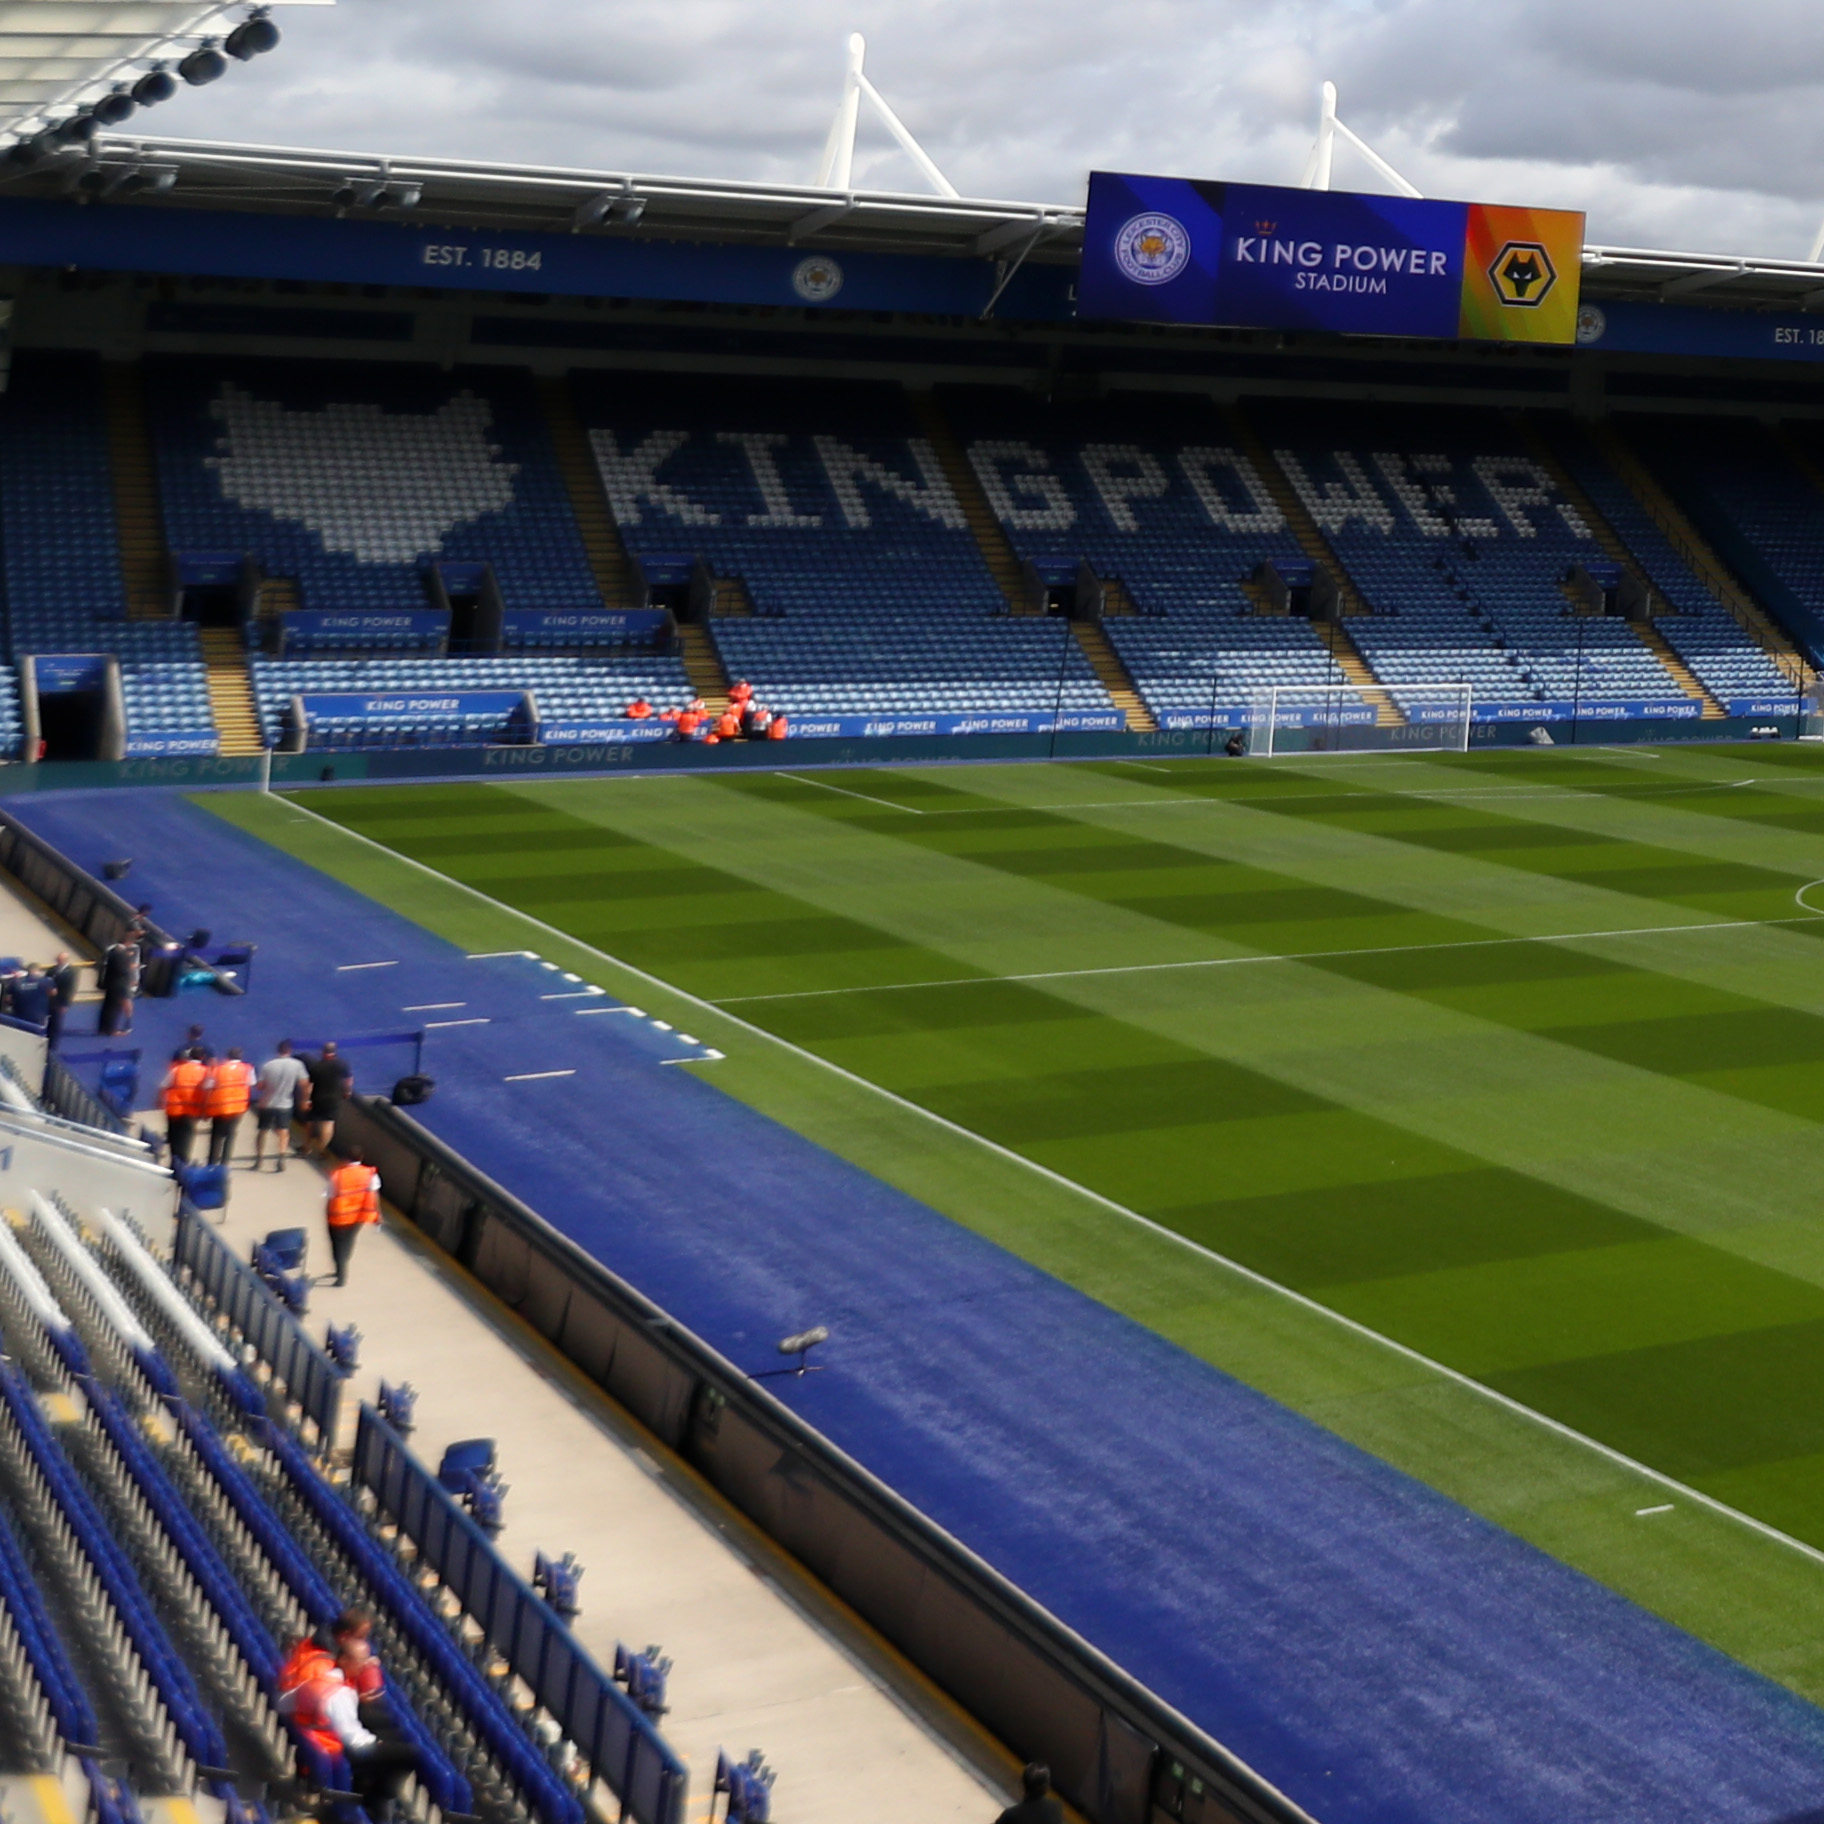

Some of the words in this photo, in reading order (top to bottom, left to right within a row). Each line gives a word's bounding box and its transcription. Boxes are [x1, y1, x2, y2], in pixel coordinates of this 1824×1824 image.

[423, 245, 473, 266] EST.
[482, 247, 542, 271] 1884
[1236, 237, 1323, 267] KING
[1334, 244, 1448, 276] POWER
[1296, 271, 1387, 295] STADIUM
[1774, 327, 1804, 344] EST.
[322, 616, 359, 628] KING
[362, 616, 413, 628] POWER
[545, 616, 576, 626] KING
[581, 615, 626, 626] POWER
[367, 700, 403, 712] KING
[408, 698, 460, 711] POWER
[1644, 706, 1665, 715] KING
[1751, 703, 1772, 713] KING
[1498, 708, 1520, 717] KING
[1523, 708, 1553, 717] POWER
[898, 720, 936, 730] POWER
[991, 719, 1029, 729] POWER
[1081, 717, 1117, 726] POWER
[546, 728, 576, 740] KING
[580, 726, 624, 739] POWER
[632, 727, 663, 738] KING
[800, 723, 841, 733] POWER
[127, 738, 167, 753] KING
[170, 737, 219, 752] POWER
[483, 749, 545, 766] KING
[552, 746, 633, 764] POWER
